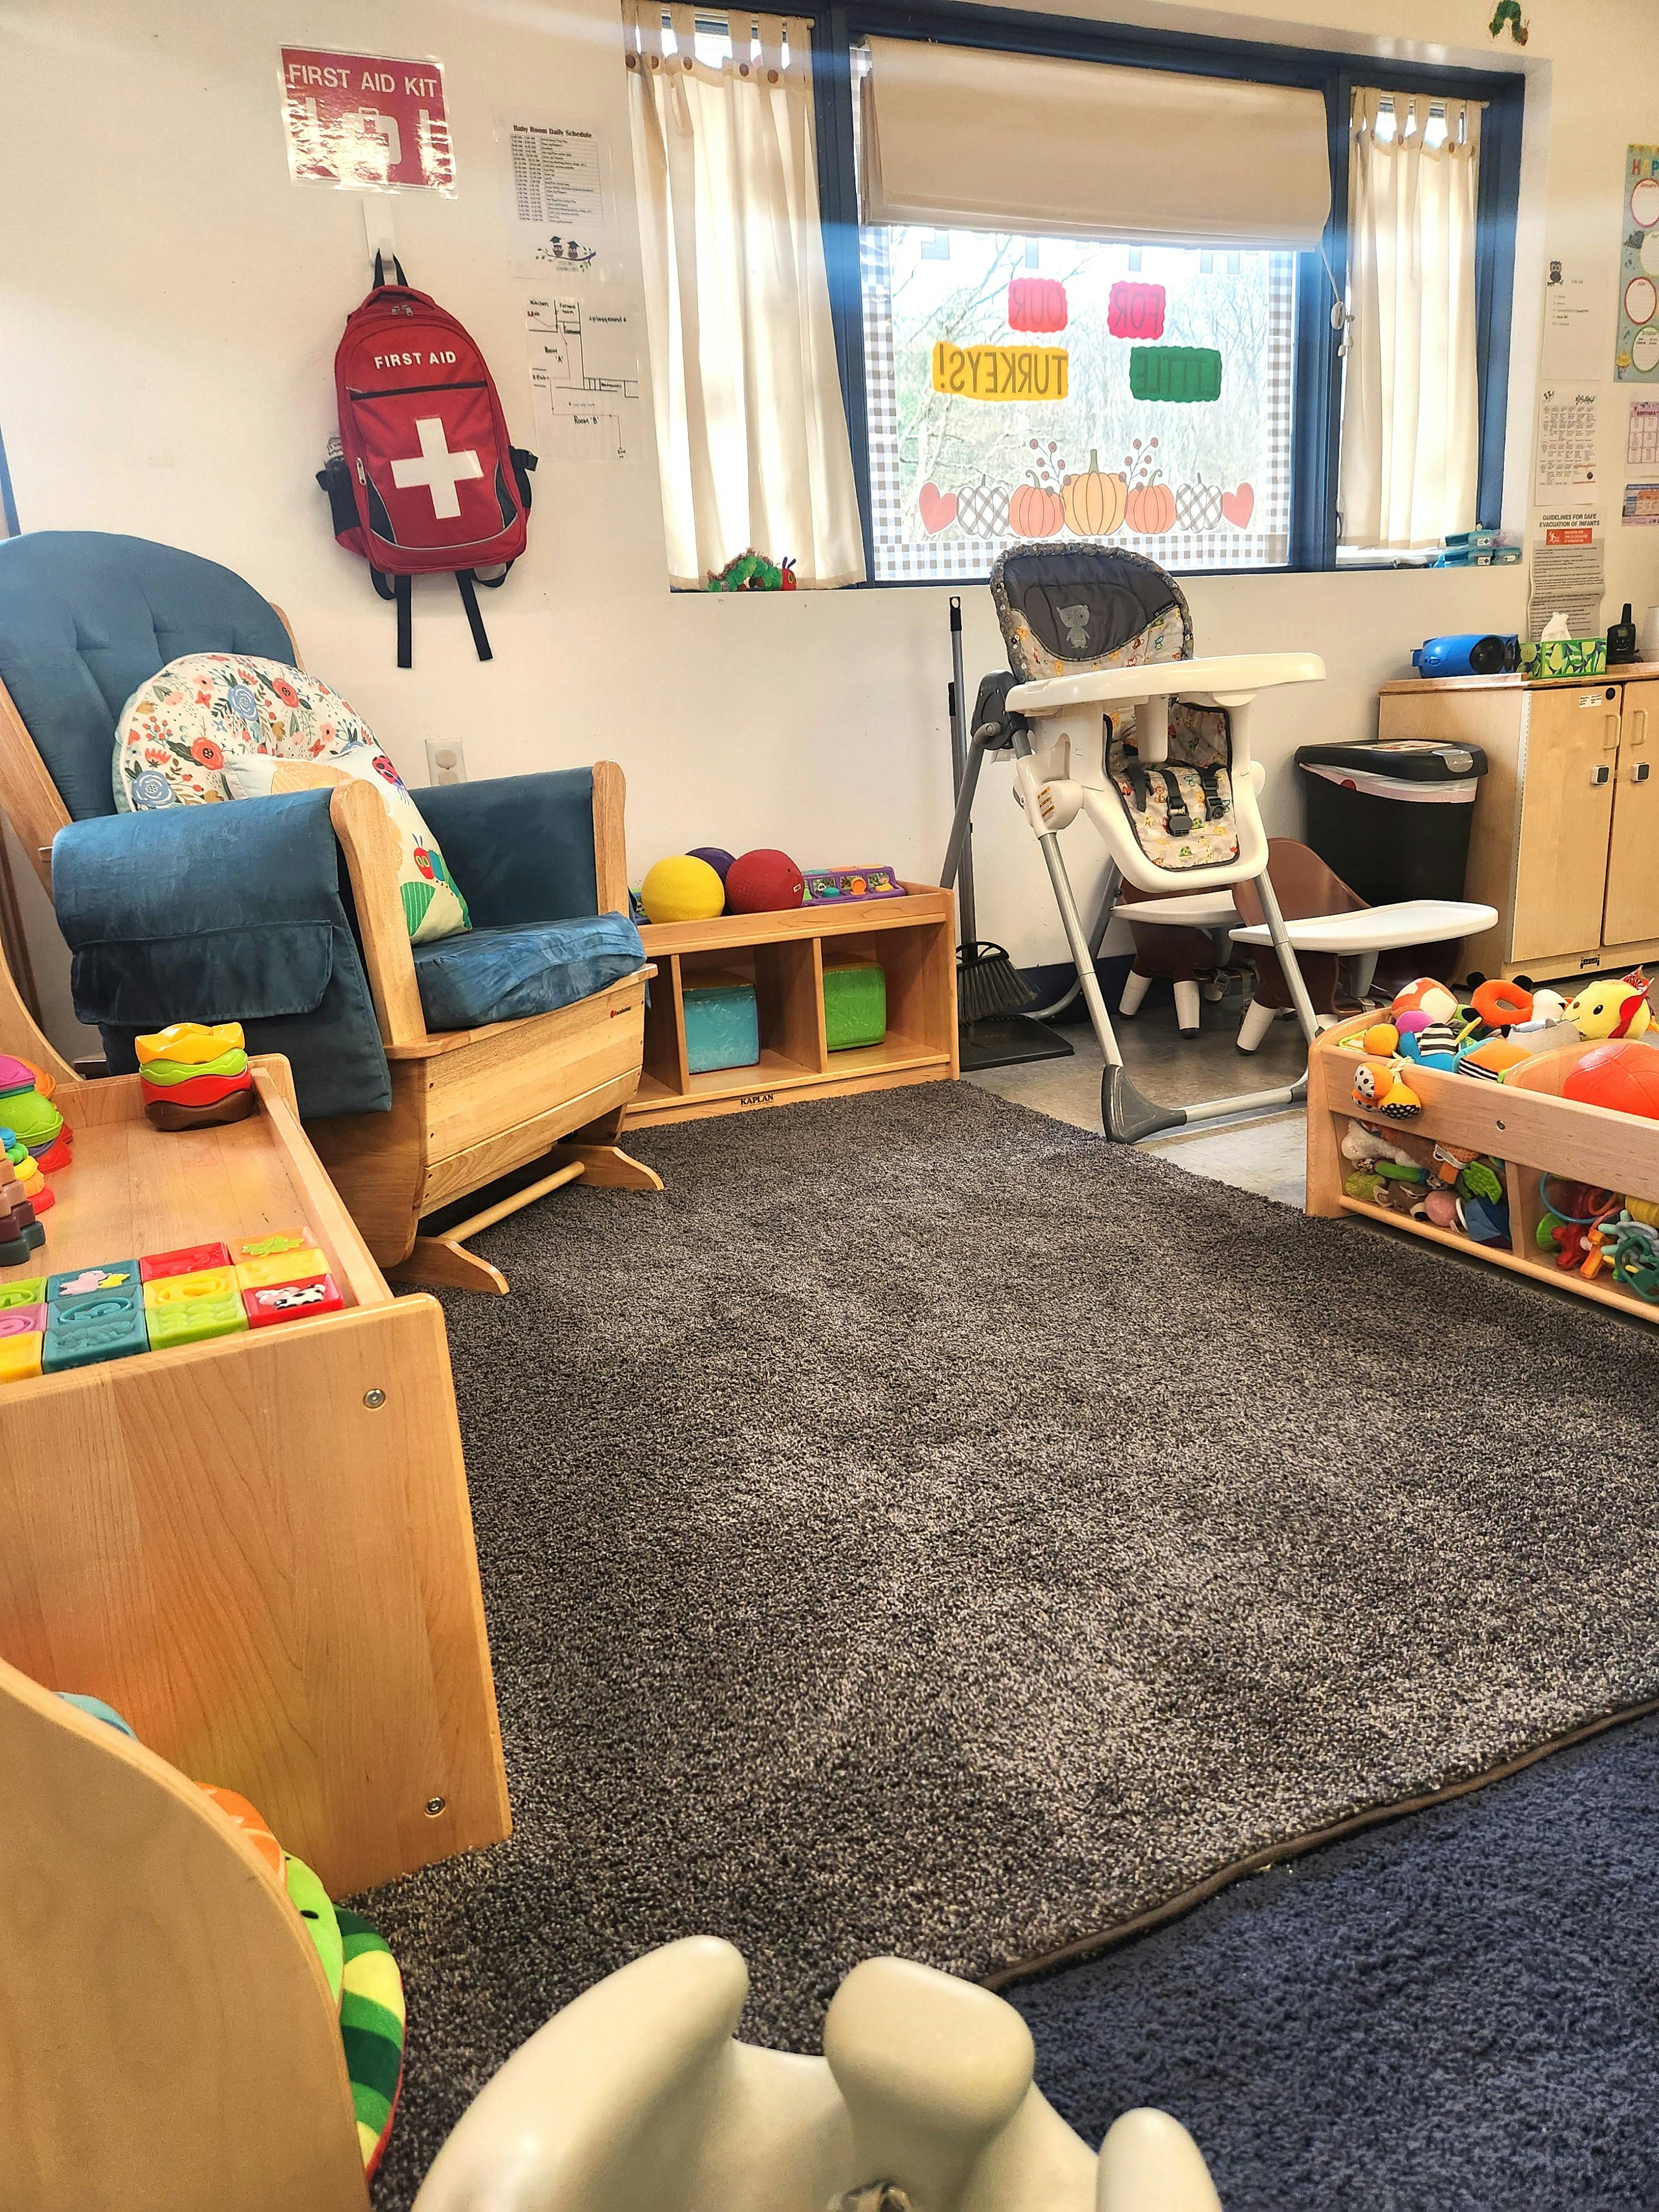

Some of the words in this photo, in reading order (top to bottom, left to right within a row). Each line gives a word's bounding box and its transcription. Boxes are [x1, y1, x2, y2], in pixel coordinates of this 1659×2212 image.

[289, 64, 350, 88] FIRST
[361, 72, 395, 93] AID
[405, 77, 437, 97] KIT
[513, 125, 529, 133] Baby
[549, 128, 564, 137] Daily
[565, 130, 593, 138] Schedule
[374, 352, 422, 369] FIRST
[429, 351, 456, 364] AID
[740, 1094, 774, 1105] KAPLAN
